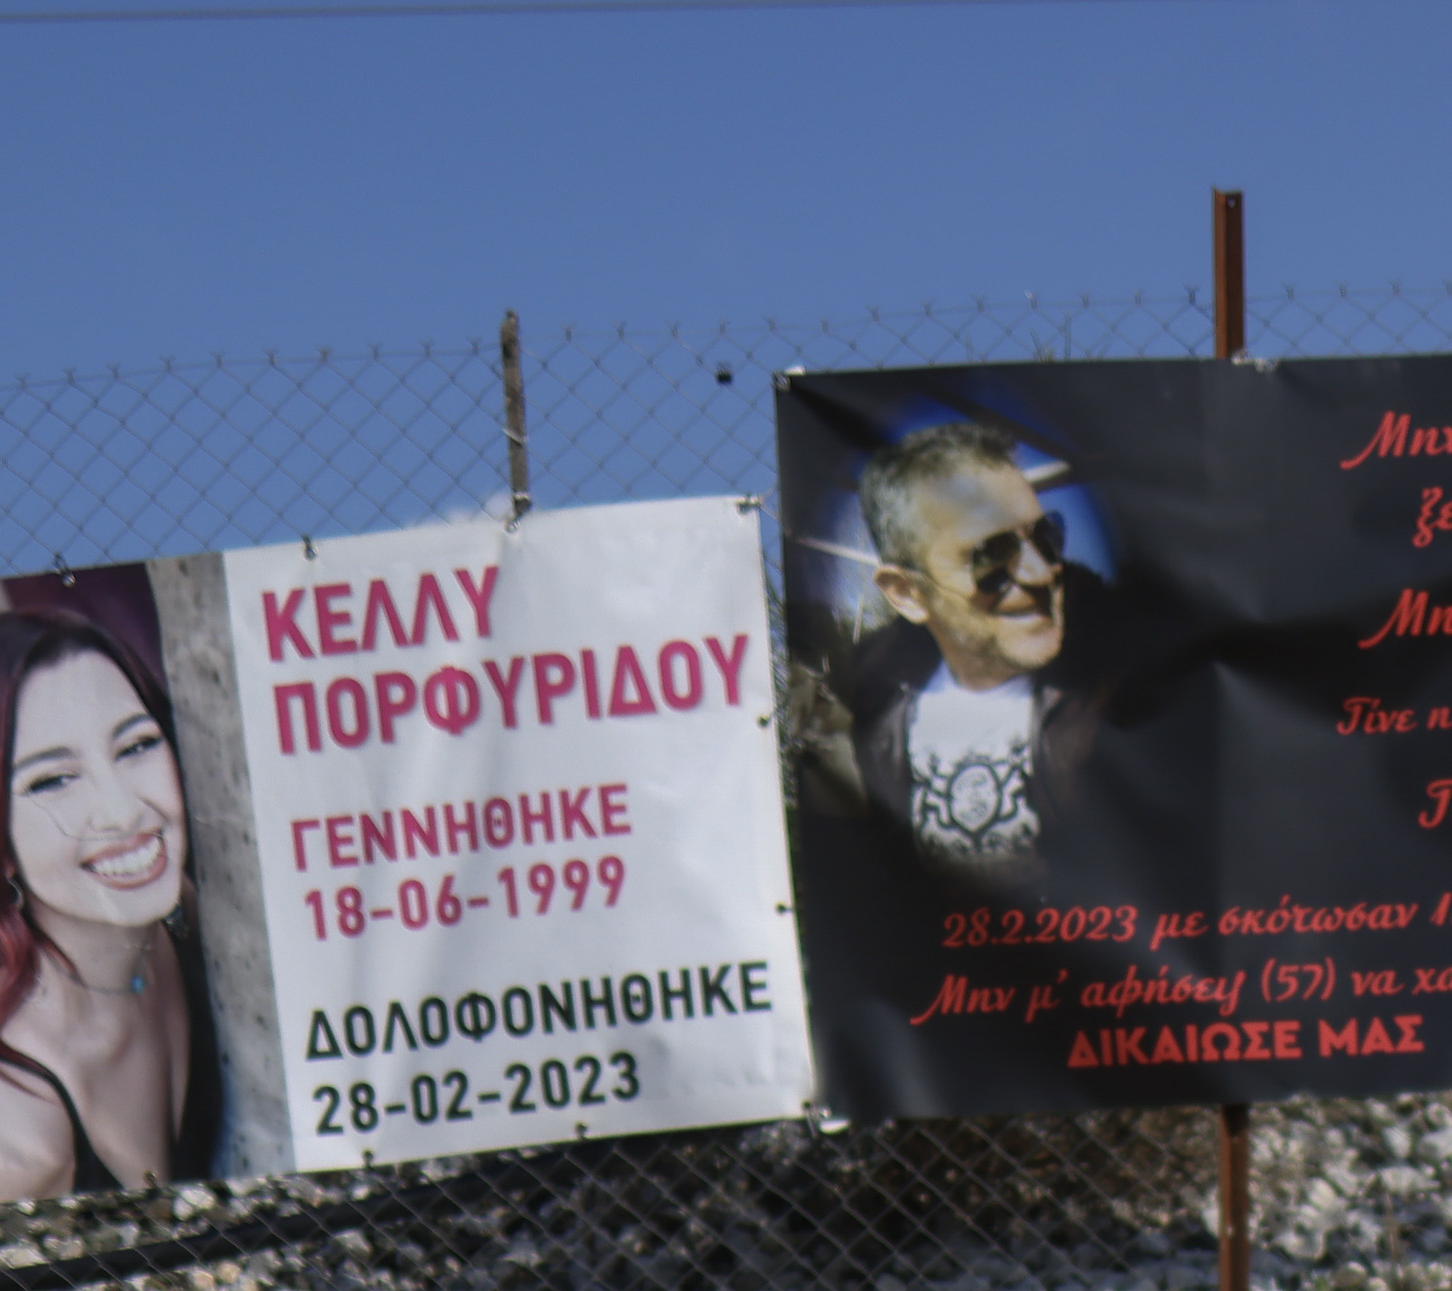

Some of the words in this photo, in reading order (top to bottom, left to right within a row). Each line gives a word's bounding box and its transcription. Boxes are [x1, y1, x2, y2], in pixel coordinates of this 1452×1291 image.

[262, 566, 499, 662] ΚΕΛΛΥ
[274, 635, 748, 754] ΠΟΡΦΥΡΙΔΟΥ
[1338, 697, 1416, 734] Γίνε
[292, 784, 631, 871] ΓΕΝΝΗΘΗΚΕ
[306, 856, 625, 940] 18-06-1999
[944, 905, 1138, 947] 28.2.2023
[1150, 912, 1207, 950] με
[1218, 895, 1418, 935] σκότωσαν
[307, 962, 771, 1060] ΔΟΛΟΦΟΝΗΘΗΚΕ
[911, 975, 1014, 1025] Μην
[1026, 970, 1068, 1022] μ'
[1082, 965, 1246, 1016] αφήσεις
[1262, 958, 1336, 1001] (57)
[1352, 970, 1404, 996] να
[1068, 1020, 1302, 1067] ΔΙΚΑΙΩΣΕ
[1320, 1015, 1424, 1057] ΜΑΣ
[314, 1052, 640, 1134] 28-02-2023
